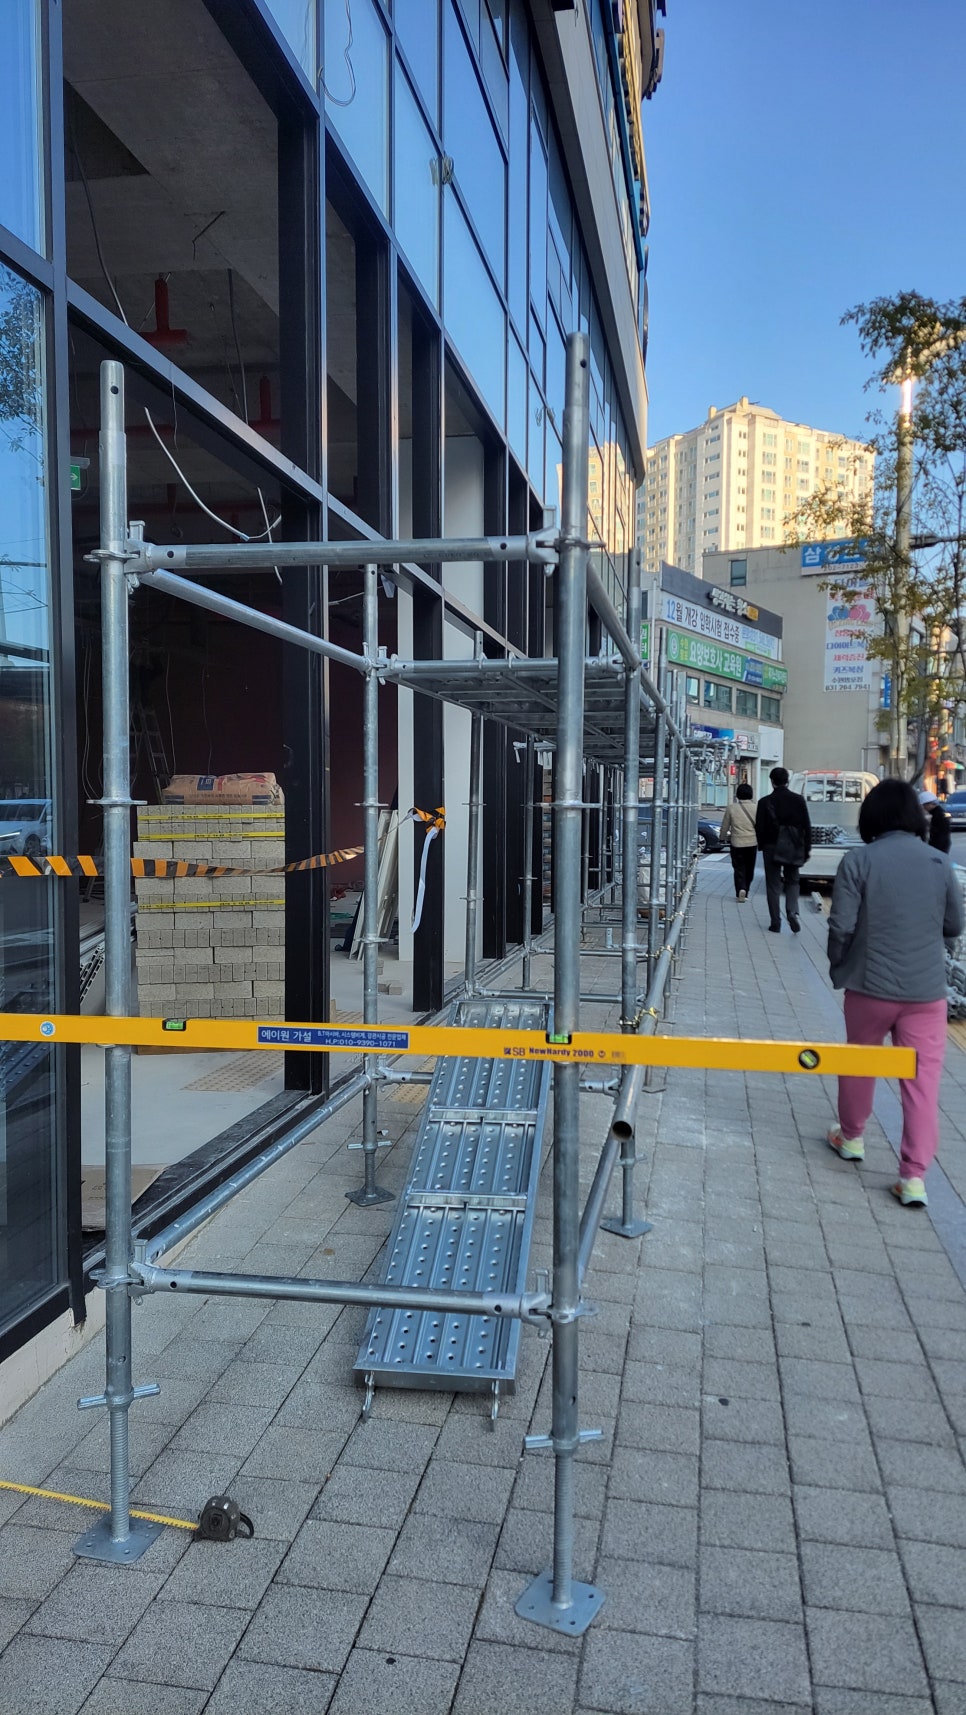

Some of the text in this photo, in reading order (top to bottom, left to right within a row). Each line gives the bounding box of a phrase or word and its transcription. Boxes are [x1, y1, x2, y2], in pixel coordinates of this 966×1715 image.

[666, 599, 683, 623] 12월
[684, 606, 698, 628] 개강
[699, 611, 722, 637] 입학시험
[723, 621, 740, 643] 접수중
[689, 641, 723, 672] 요양보호사
[723, 653, 742, 677] 교육원
[832, 665, 864, 674] 키즈복싱
[261, 1029, 290, 1041] 에이원
[293, 1030, 312, 1043] 가설
[512, 1047, 594, 1058] SB NewHardy 2000
